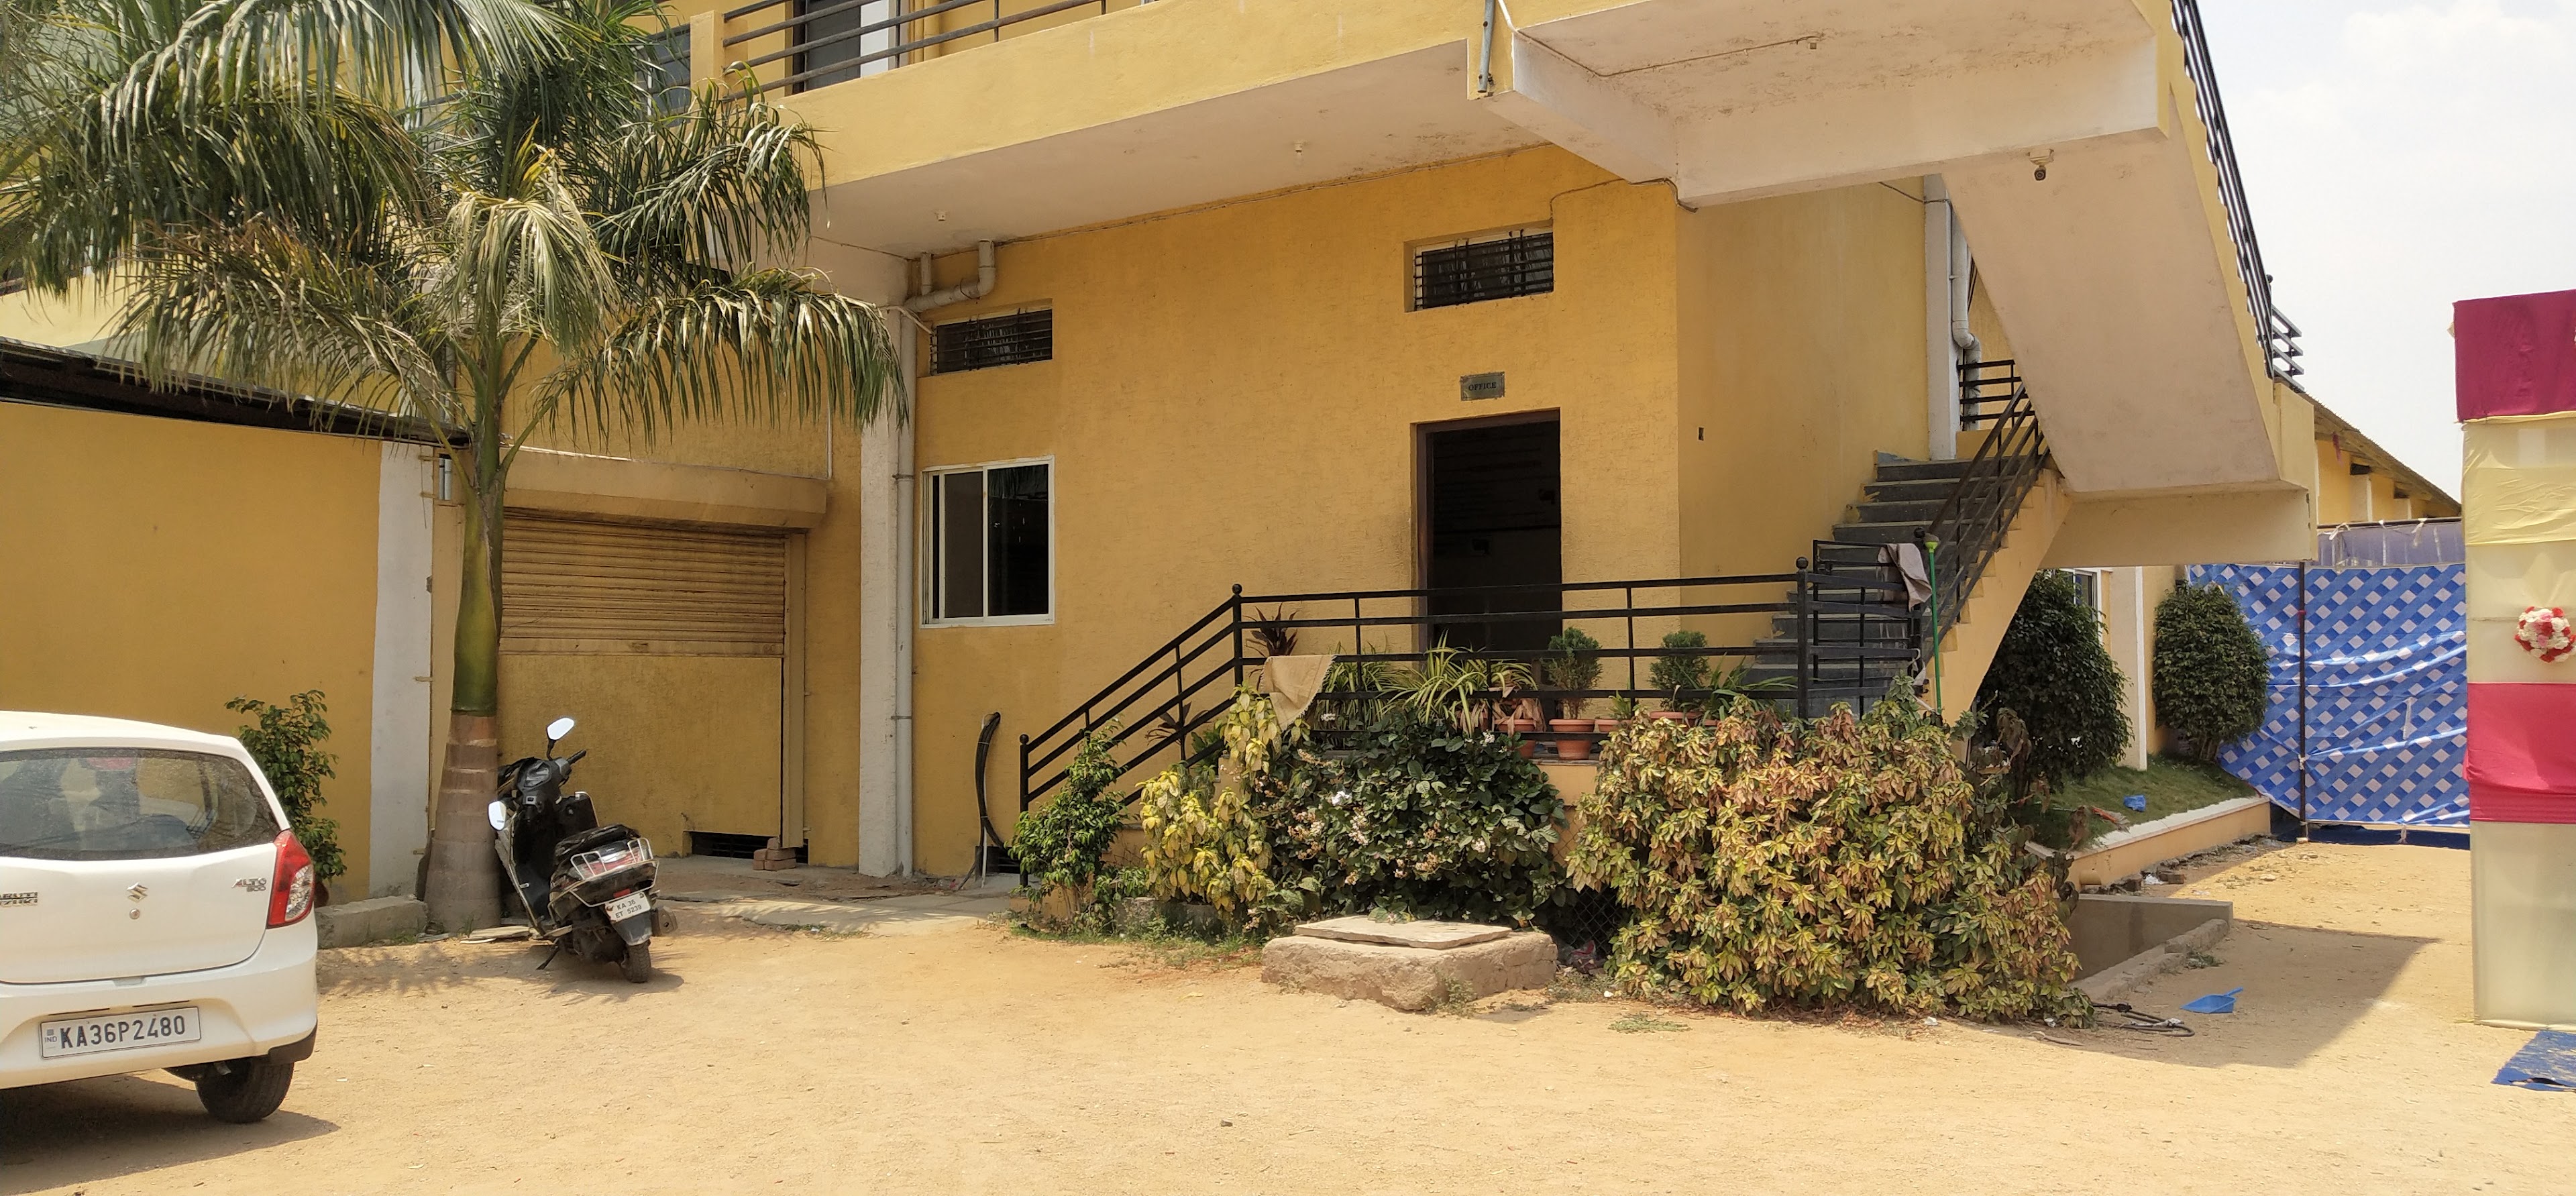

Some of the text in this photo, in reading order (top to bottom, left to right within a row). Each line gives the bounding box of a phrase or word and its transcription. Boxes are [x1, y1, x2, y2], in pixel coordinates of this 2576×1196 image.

[1468, 382, 1497, 391] OFFICE
[231, 878, 267, 888] ALTO
[0, 899, 38, 907] ZUKI
[627, 904, 642, 914] 5239
[60, 1015, 186, 1049] KA36P2480
